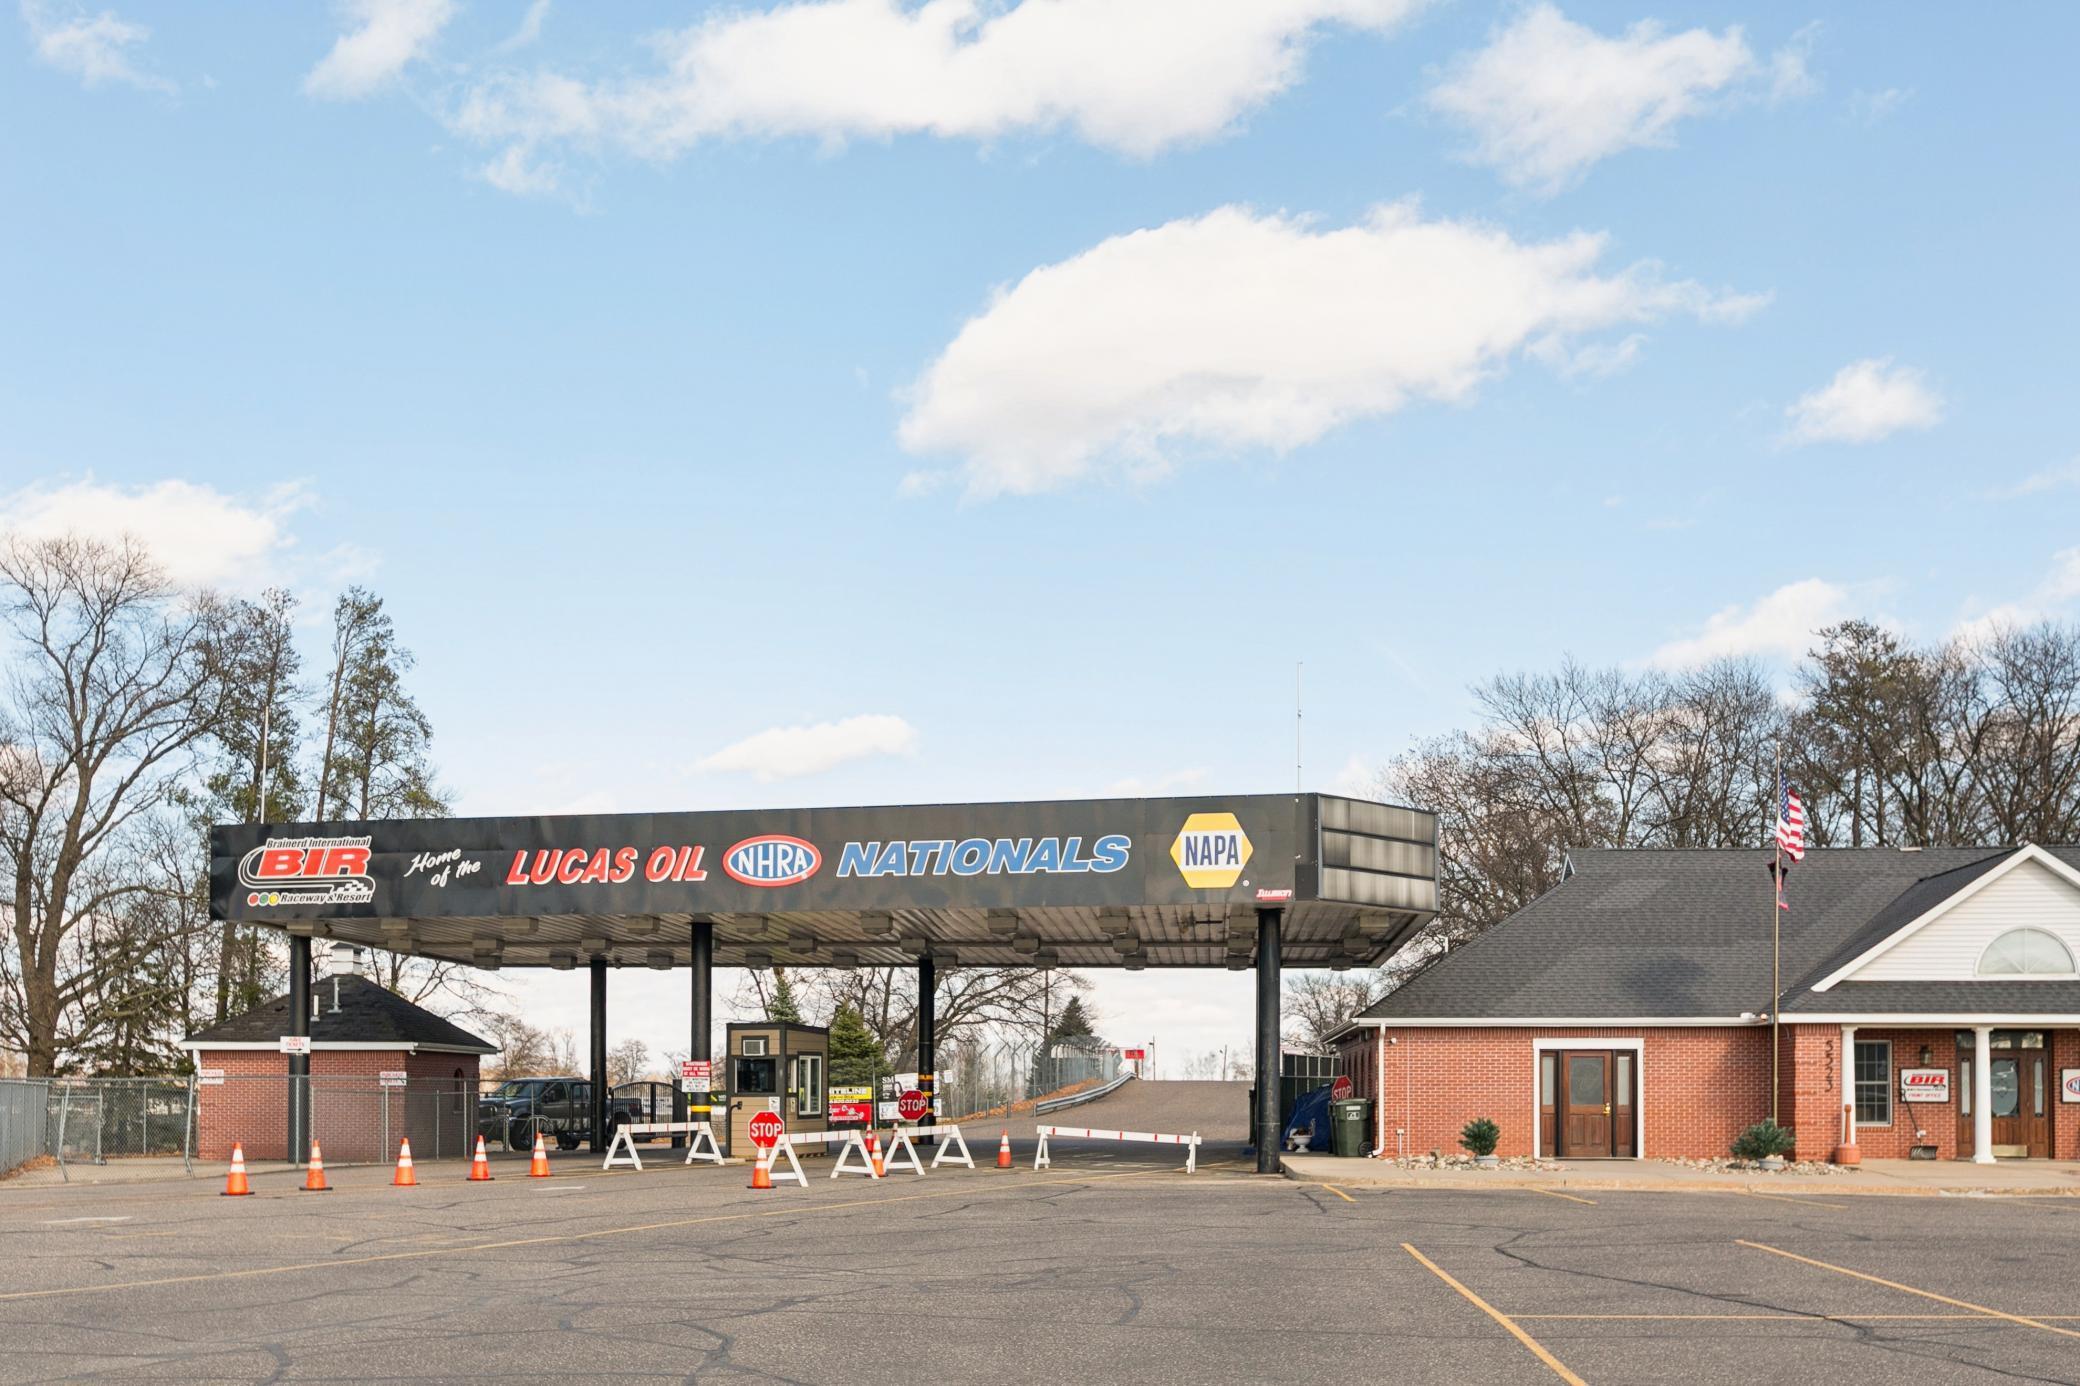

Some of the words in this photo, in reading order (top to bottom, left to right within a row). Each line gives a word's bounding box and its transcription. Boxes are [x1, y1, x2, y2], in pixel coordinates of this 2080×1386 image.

[266, 838, 308, 848] Brainerd
[309, 835, 371, 847] International
[1185, 835, 1239, 866] NAPA
[257, 847, 371, 877] BIR
[404, 848, 461, 877] Home
[506, 847, 638, 885] LUCAS
[645, 846, 707, 882] OIL
[738, 843, 808, 877] NHRA
[836, 835, 1131, 877] NATIONALS
[430, 865, 451, 888] of
[456, 860, 481, 878] the
[281, 893, 325, 904] Raceway
[336, 892, 372, 902] Resort
[1824, 1040, 1833, 1092] 5523
[1909, 1075, 1945, 1084] BIR
[900, 1099, 926, 1111] STOP
[1334, 1085, 1351, 1099] STOP
[750, 1122, 782, 1137] STOP
